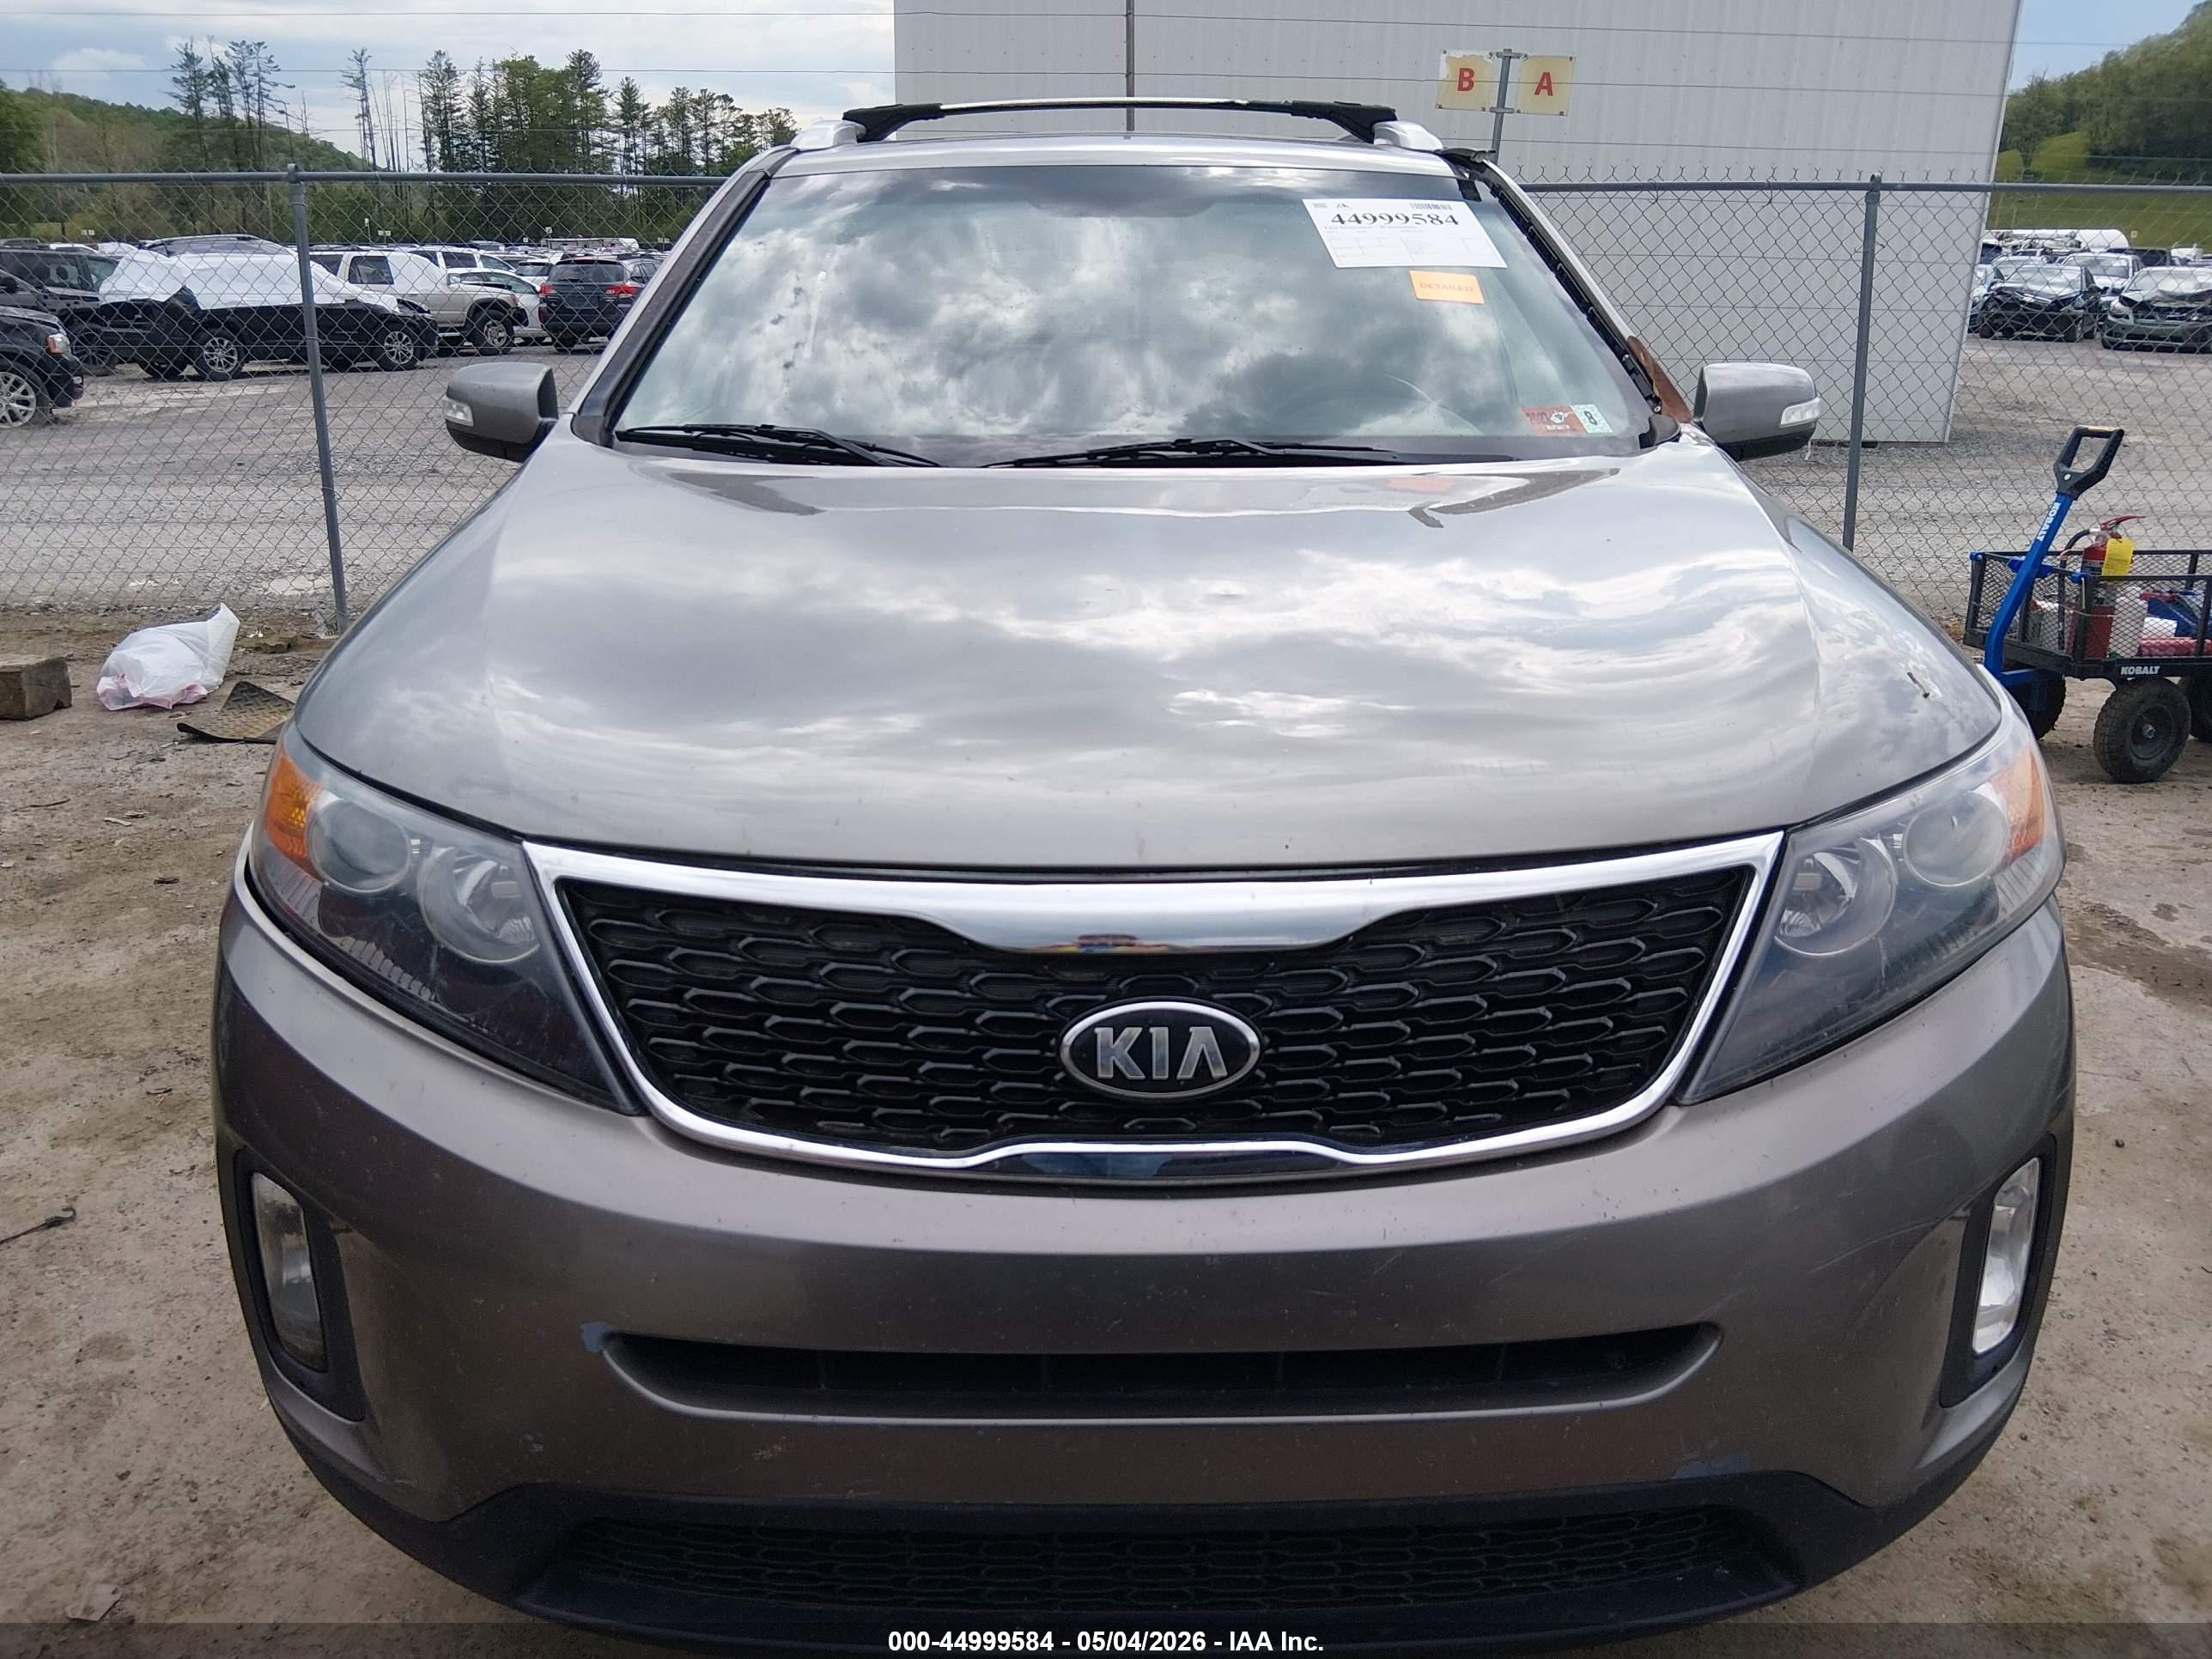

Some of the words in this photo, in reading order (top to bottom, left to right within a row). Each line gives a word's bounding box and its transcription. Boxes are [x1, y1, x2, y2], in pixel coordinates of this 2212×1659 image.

[1457, 67, 1475, 92] B
[1534, 71, 1553, 96] A
[1331, 212, 1460, 226] 44999584
[2036, 501, 2062, 542] KOBALT
[2120, 665, 2160, 675] KOBALT
[1094, 1026, 1228, 1079] KIA
